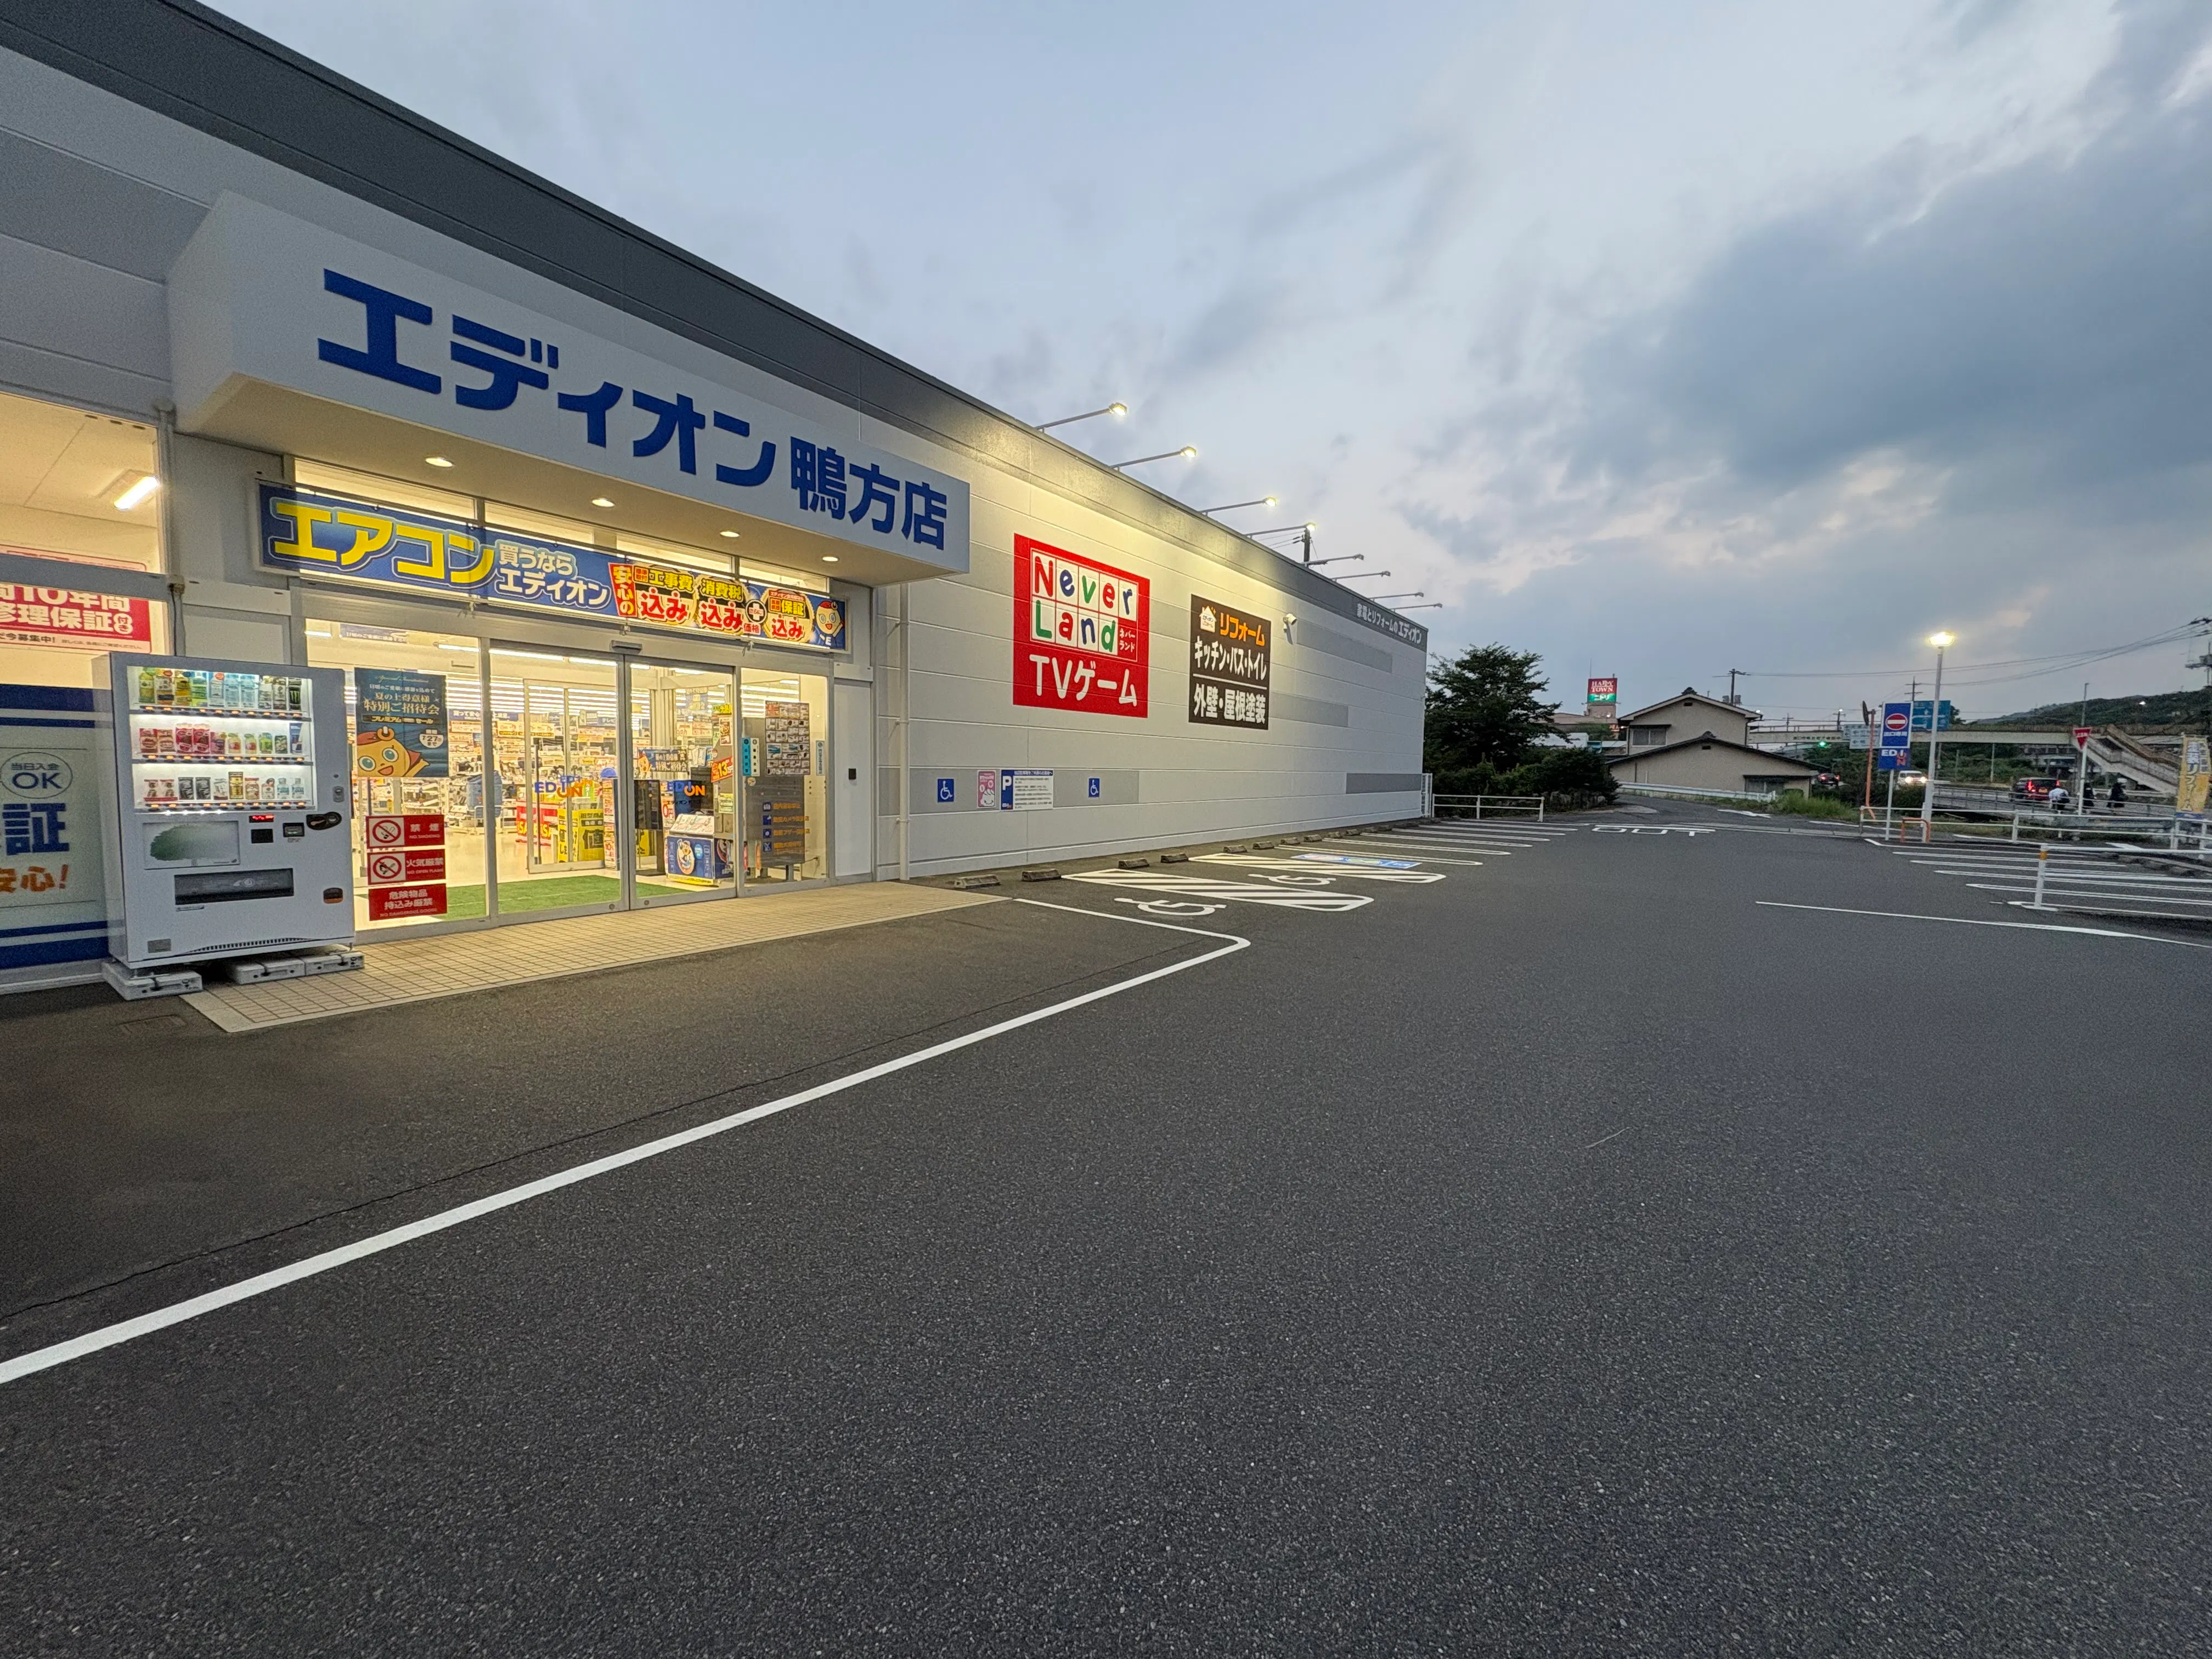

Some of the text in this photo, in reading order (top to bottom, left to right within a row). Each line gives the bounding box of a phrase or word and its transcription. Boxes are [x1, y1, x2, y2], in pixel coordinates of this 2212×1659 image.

[318, 268, 947, 550] エディオン 鴨方店
[275, 502, 494, 583] エアコン
[499, 544, 573, 575] 買うなら
[499, 568, 607, 605] エディオン
[613, 566, 634, 614] 安心の
[649, 569, 693, 591] 工事費
[702, 579, 742, 601] 消費税
[1034, 556, 1133, 615] Never
[641, 592, 687, 620] 込み
[701, 603, 742, 630] 込み
[782, 600, 804, 616] 保証
[743, 624, 760, 633] 価格
[772, 618, 803, 637] 込み
[1035, 600, 1116, 653] Land
[1119, 628, 1136, 639] ネバー
[1219, 612, 1266, 646] リフォーム
[1356, 603, 1422, 645] 家電とリフォームのエディオン
[1119, 640, 1135, 653] ランド
[1194, 635, 1267, 681] キッチン・バス・トイレ
[1029, 654, 1137, 707] TVゲーム
[364, 698, 439, 715] 特別ご招待会
[1193, 683, 1266, 724] 外壁・屋根塗装
[12, 772, 63, 789] OK
[667, 781, 706, 797] EDION
[1002, 776, 1012, 791] P
